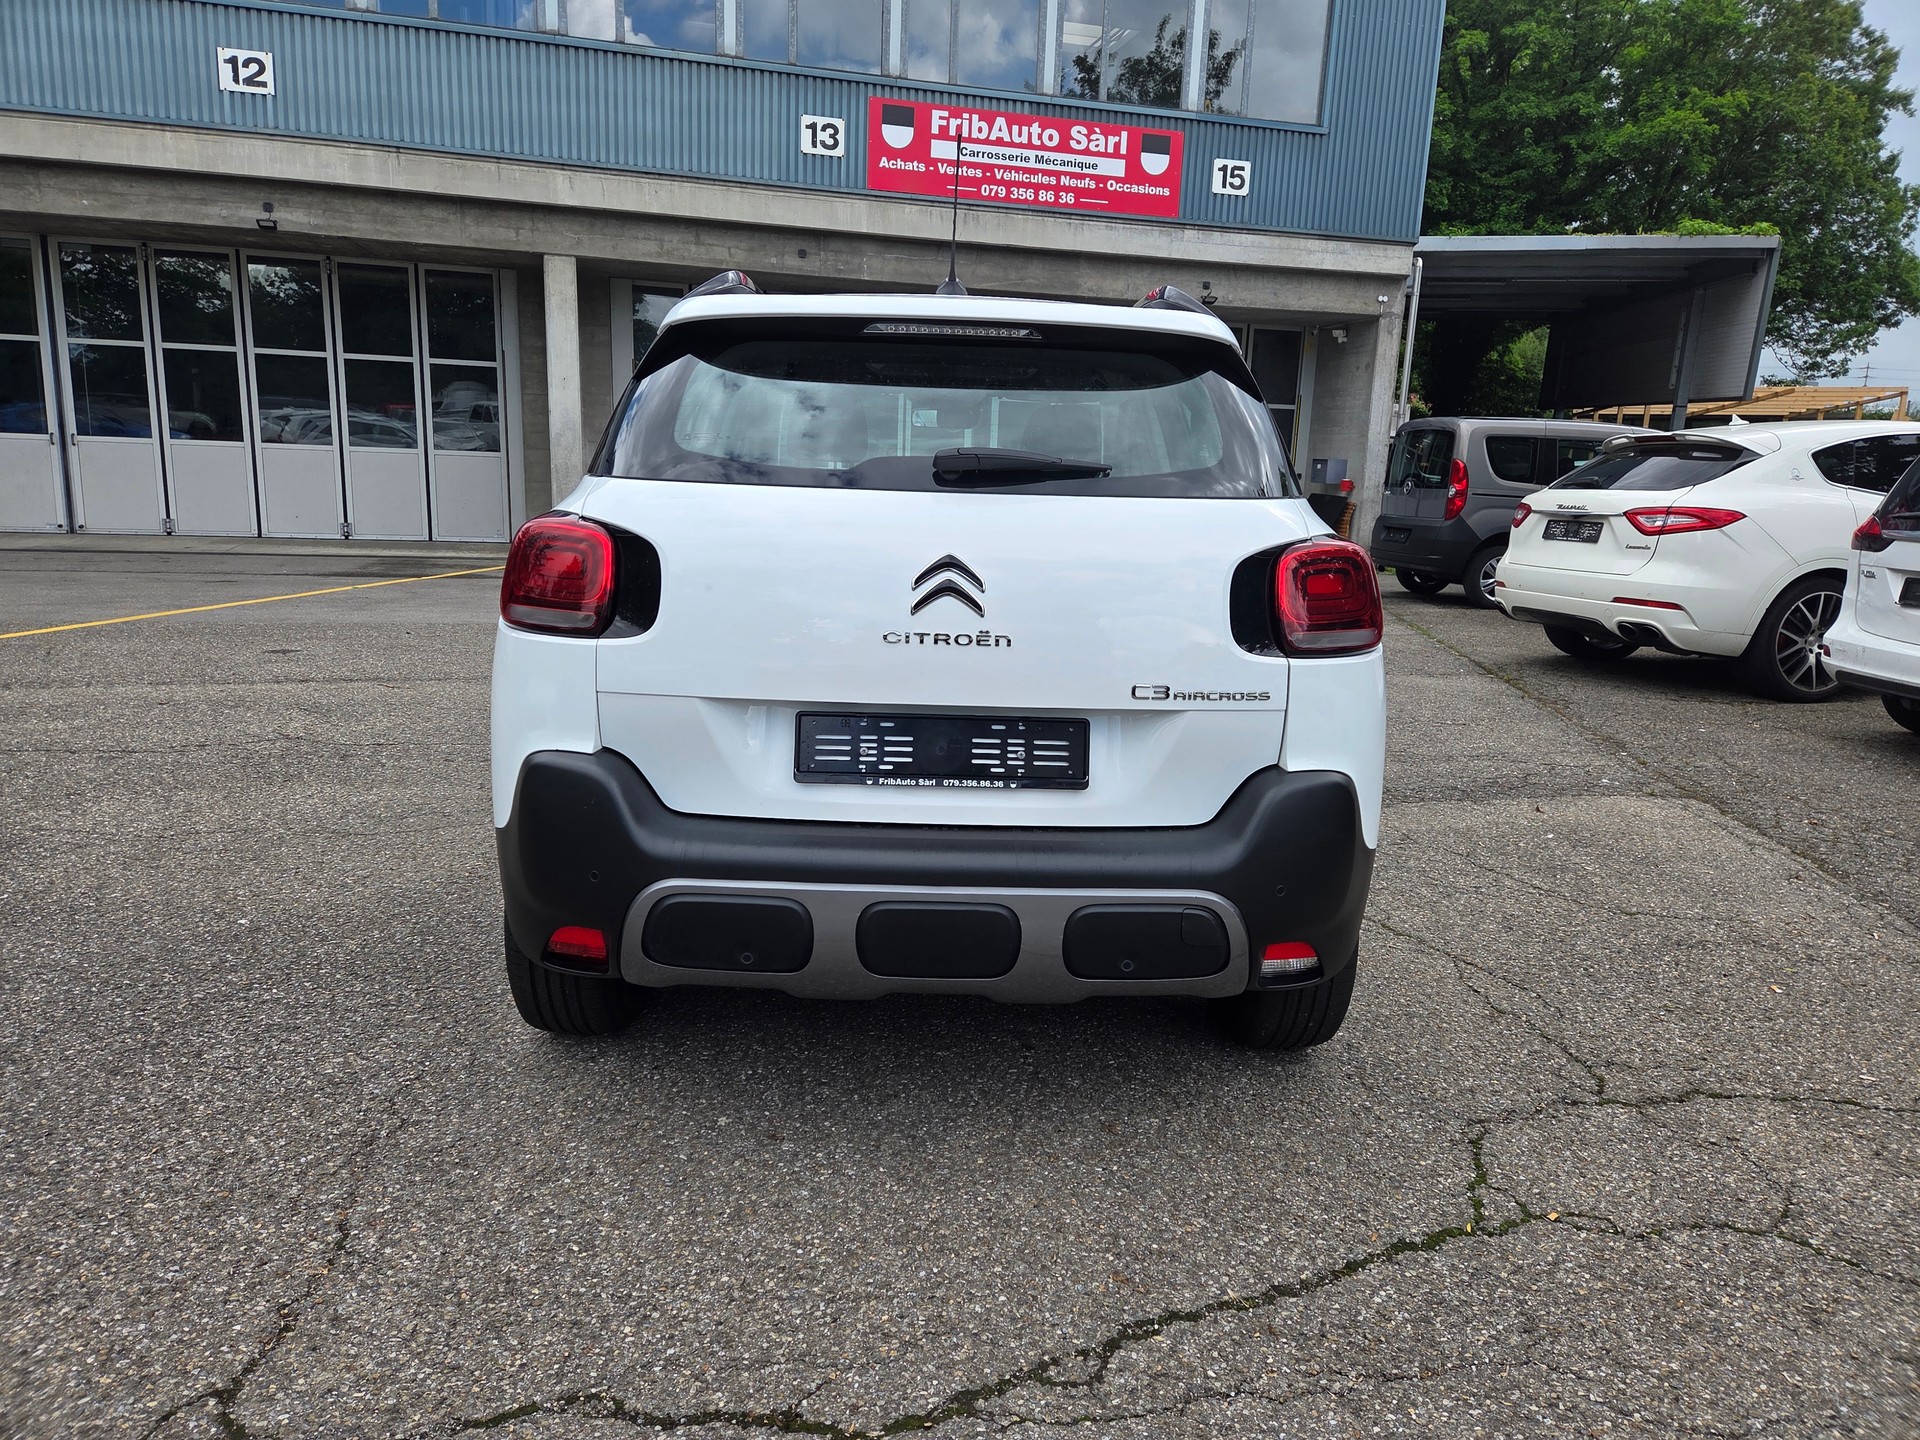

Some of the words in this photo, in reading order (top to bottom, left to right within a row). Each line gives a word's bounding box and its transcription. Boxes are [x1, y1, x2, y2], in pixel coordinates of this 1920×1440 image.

[223, 55, 268, 88] 12
[805, 121, 840, 151] 13
[931, 109, 1060, 147] FribAuto
[1069, 125, 1128, 155] Sàrl
[960, 146, 1031, 164] Carrosserie
[1034, 154, 1099, 172] Mécanique
[879, 157, 926, 172] Achats
[938, 163, 983, 178] Ventes
[994, 168, 1057, 185] Véhicules
[1060, 175, 1096, 189] Neufs
[1106, 180, 1171, 196] Occasions
[1218, 164, 1246, 190] 15
[981, 185, 1007, 198] 079
[1010, 187, 1035, 201] 356
[1038, 190, 1055, 202] 86
[1058, 192, 1075, 204] 36
[1131, 684, 1171, 701] C3
[1173, 690, 1271, 702] AIRCROSS
[879, 777, 916, 786] FribAuto
[918, 778, 936, 787] Sàrl
[943, 779, 1004, 788] 079.356.86.36
